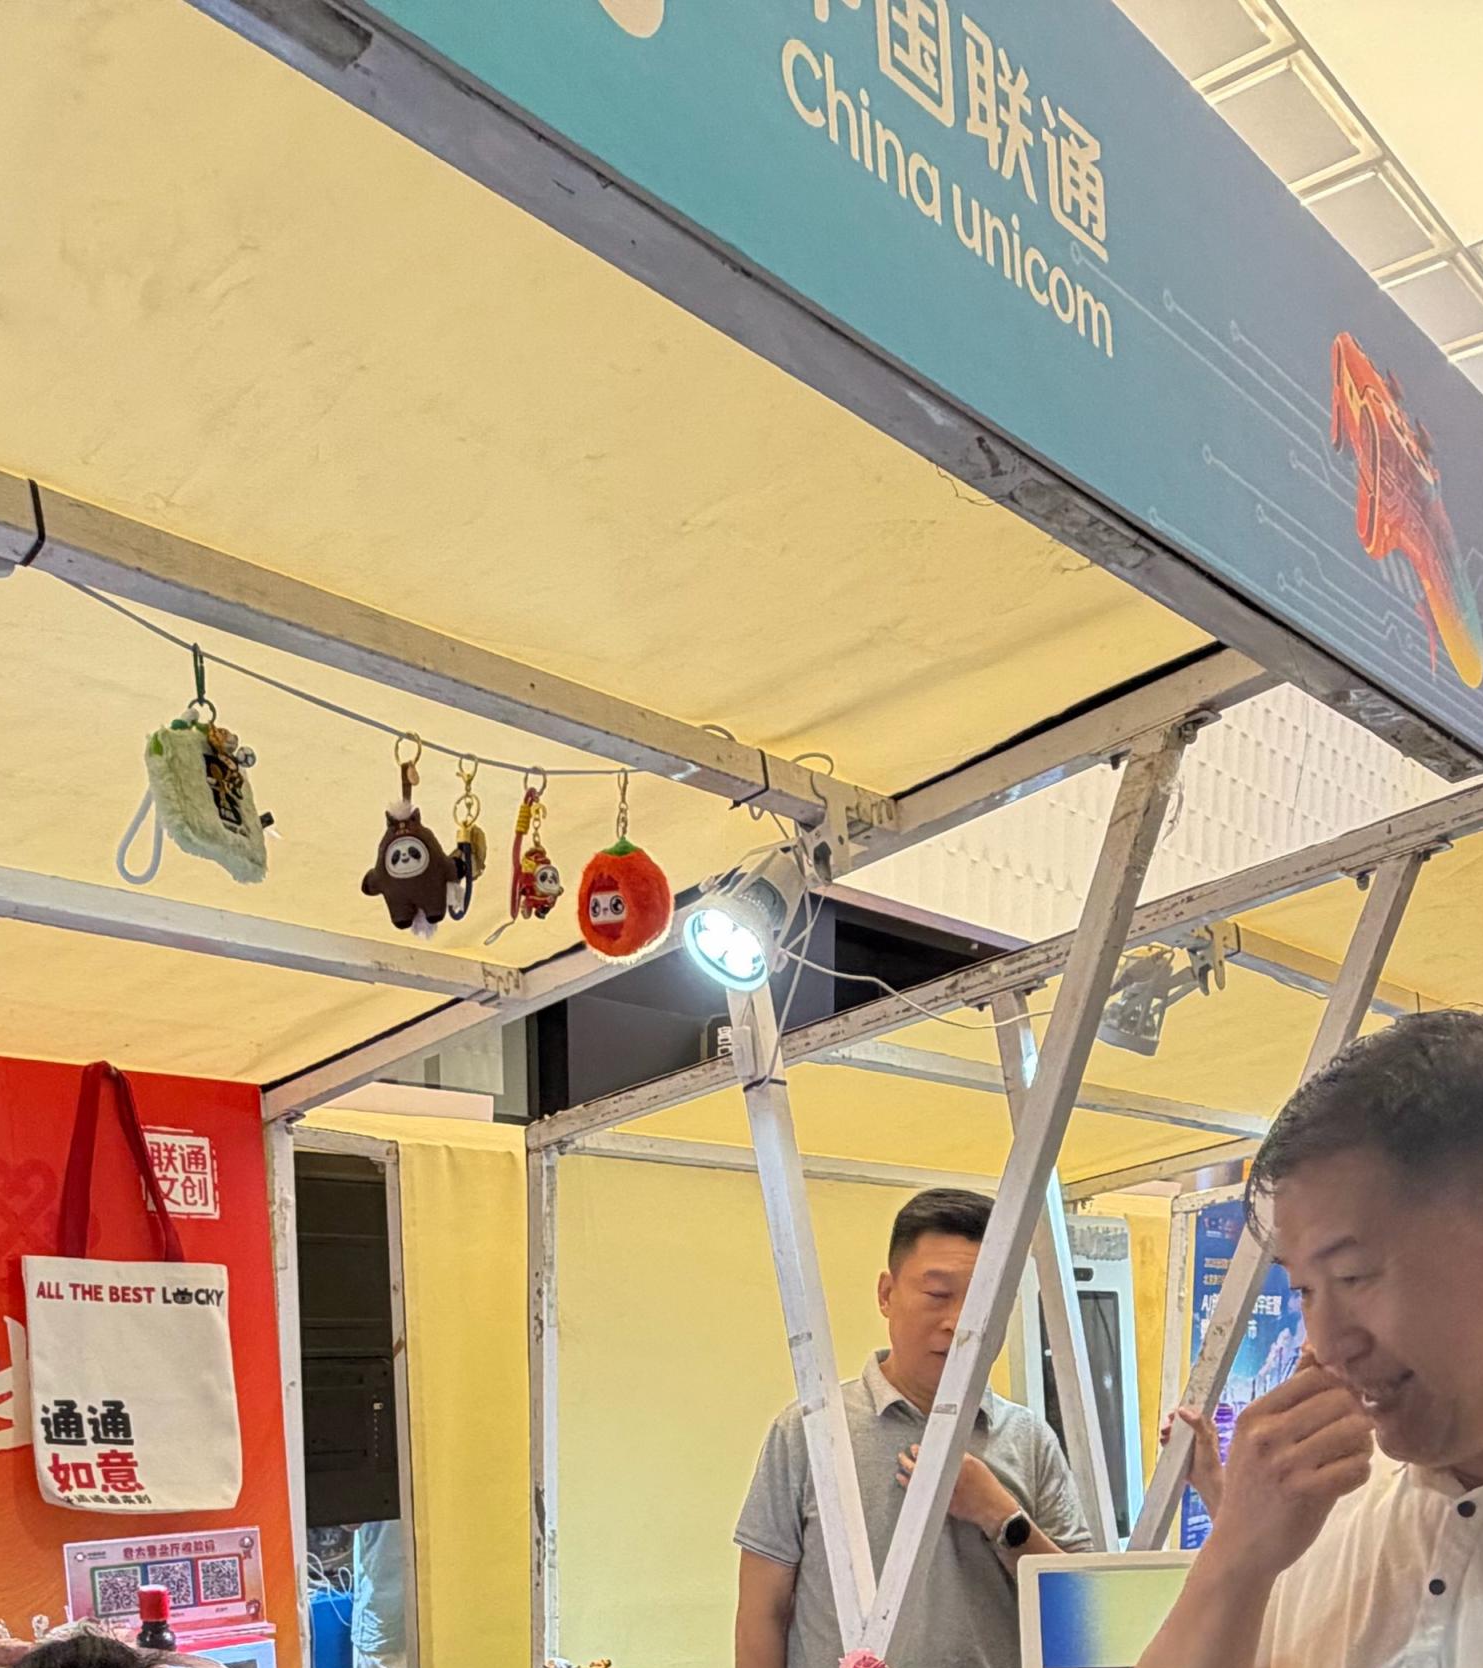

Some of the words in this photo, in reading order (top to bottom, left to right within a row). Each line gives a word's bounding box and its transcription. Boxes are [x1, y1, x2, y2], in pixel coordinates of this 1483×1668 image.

[813, 0, 1110, 262] 国联通
[781, 39, 942, 225] China
[952, 183, 1114, 358] unicom
[147, 1141, 208, 1175] 联通
[157, 1174, 210, 1207] 文创
[36, 1281, 64, 1300] ALL
[69, 1283, 104, 1303] THE
[108, 1286, 156, 1304] BEST
[40, 1399, 134, 1446] 通通
[47, 1449, 145, 1494] 如意
